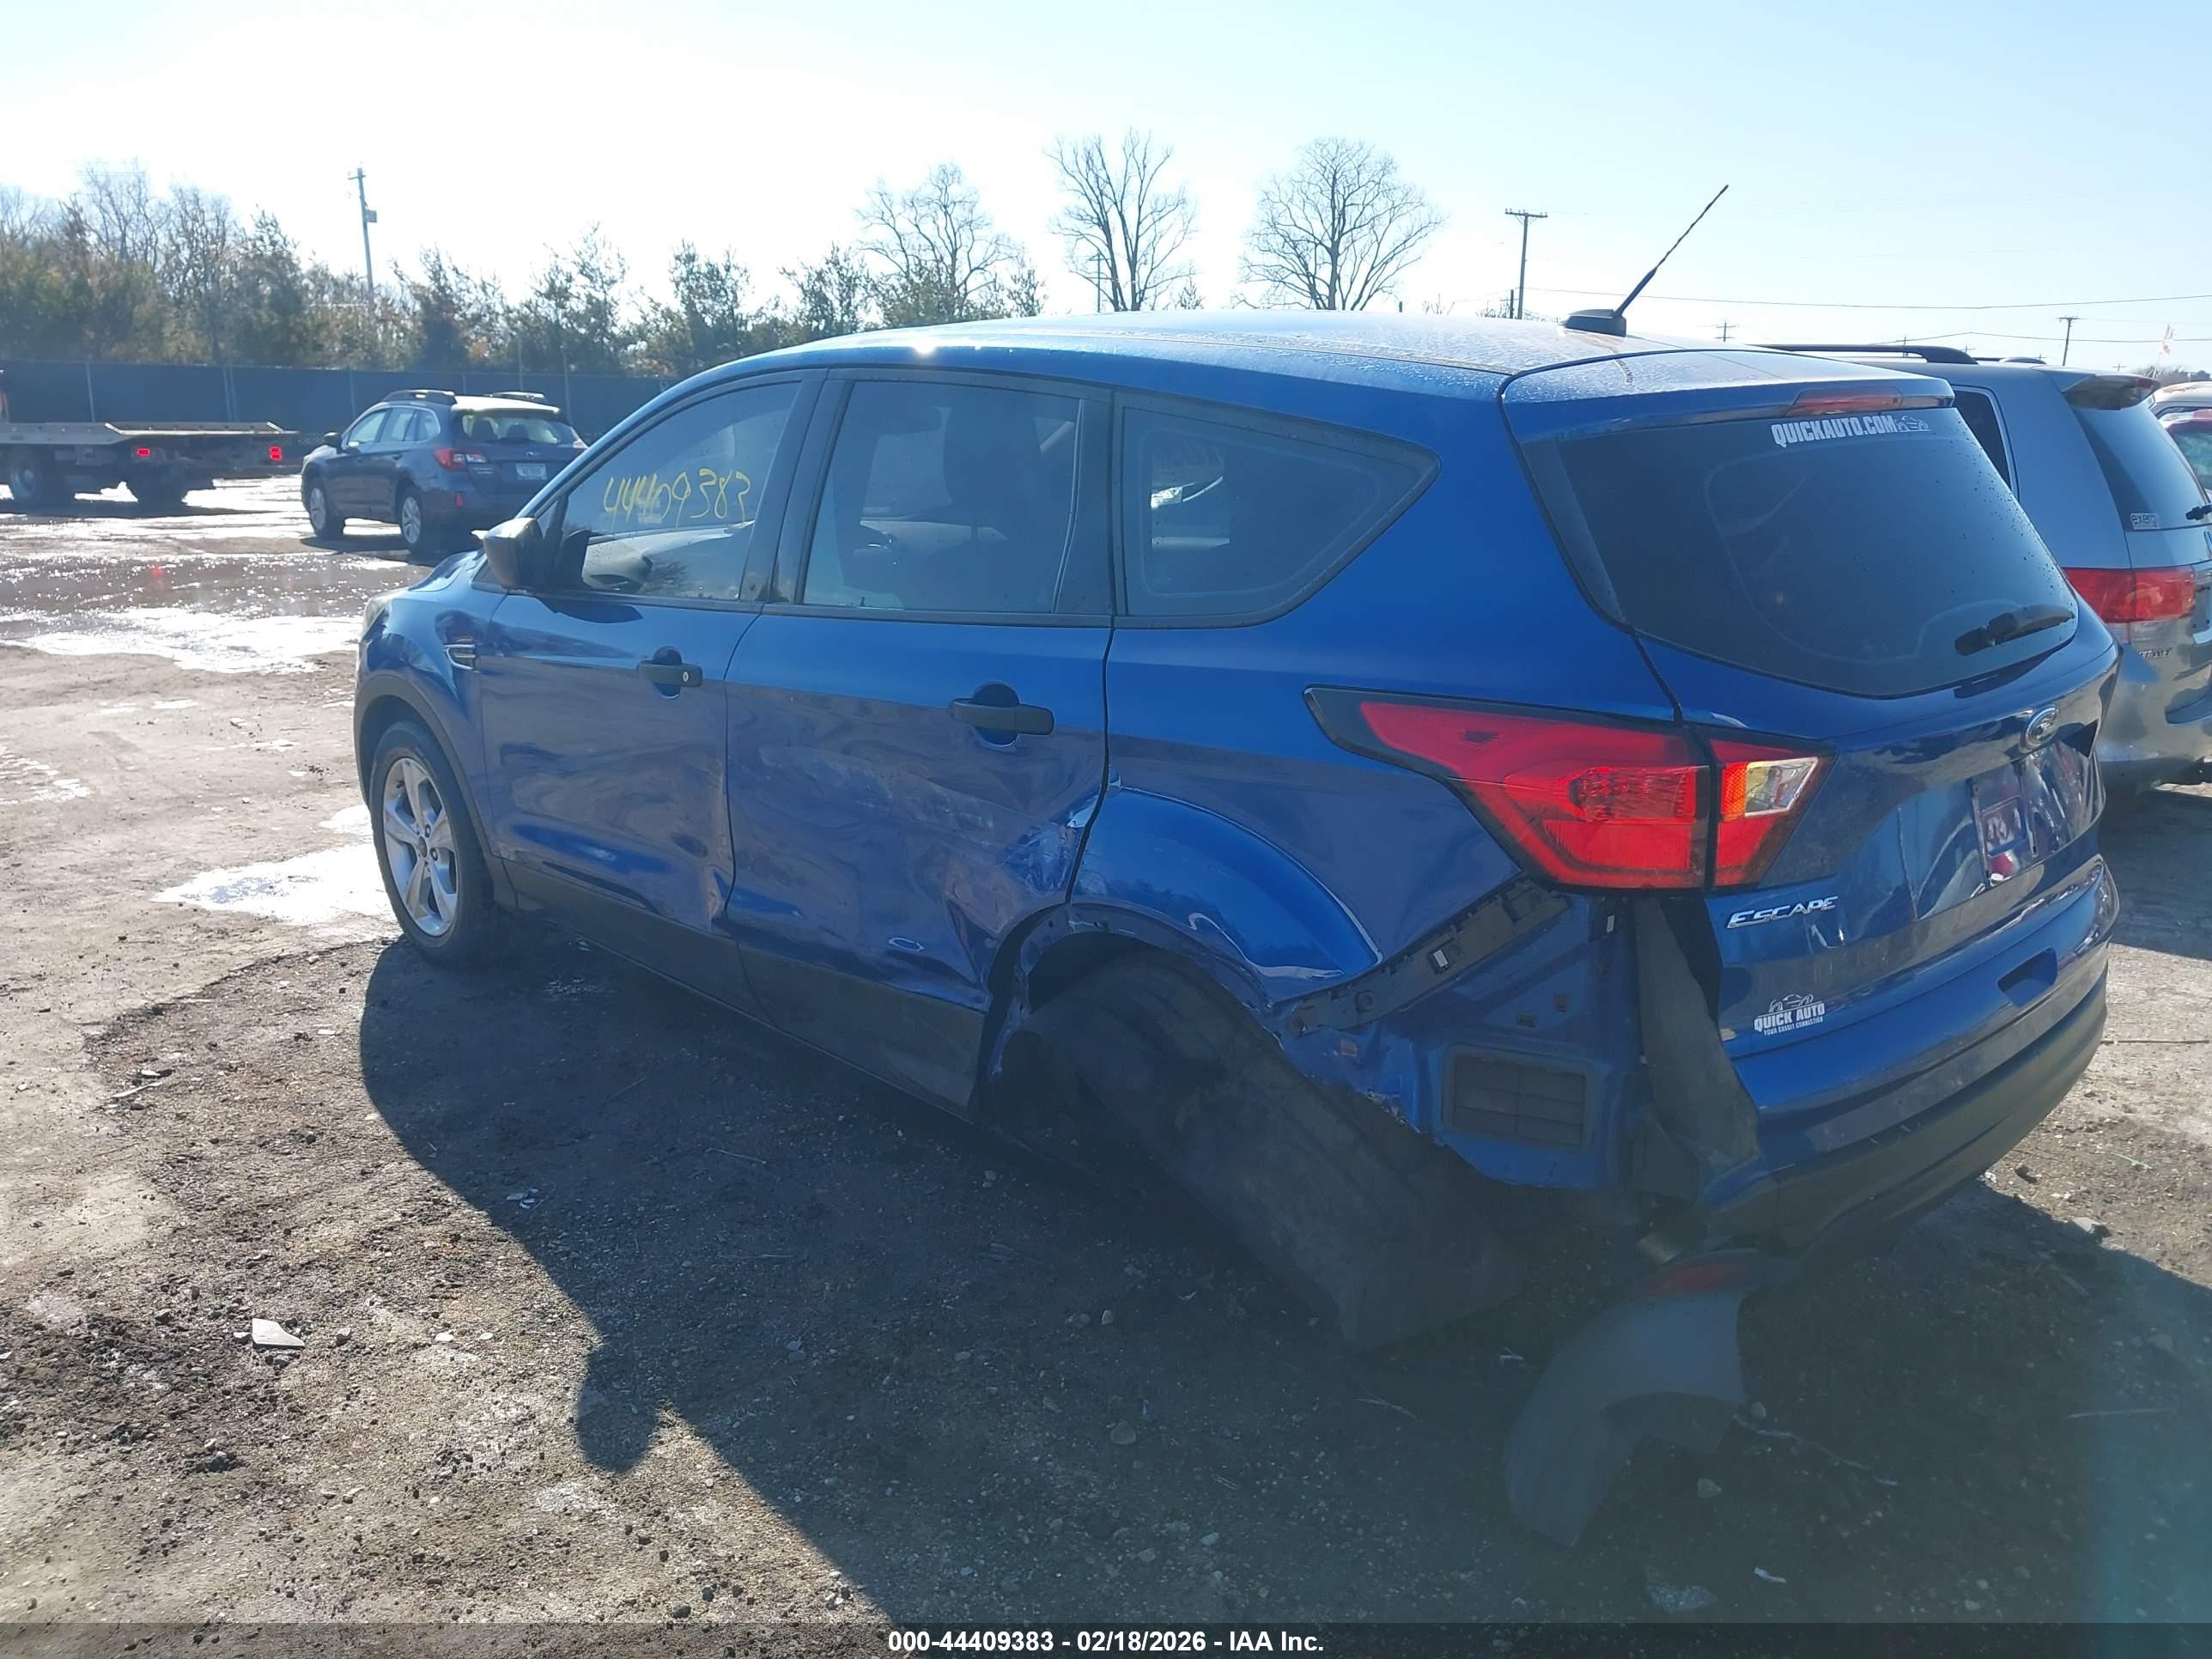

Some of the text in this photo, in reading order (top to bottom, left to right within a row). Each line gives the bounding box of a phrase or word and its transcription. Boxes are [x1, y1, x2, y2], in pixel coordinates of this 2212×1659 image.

[1771, 416, 1897, 447] QUICKAUTO.COM
[604, 469, 750, 528] 44409383
[1727, 896, 1838, 929] ESCAPE
[1754, 1003, 1826, 1032] QUICK AUTO
